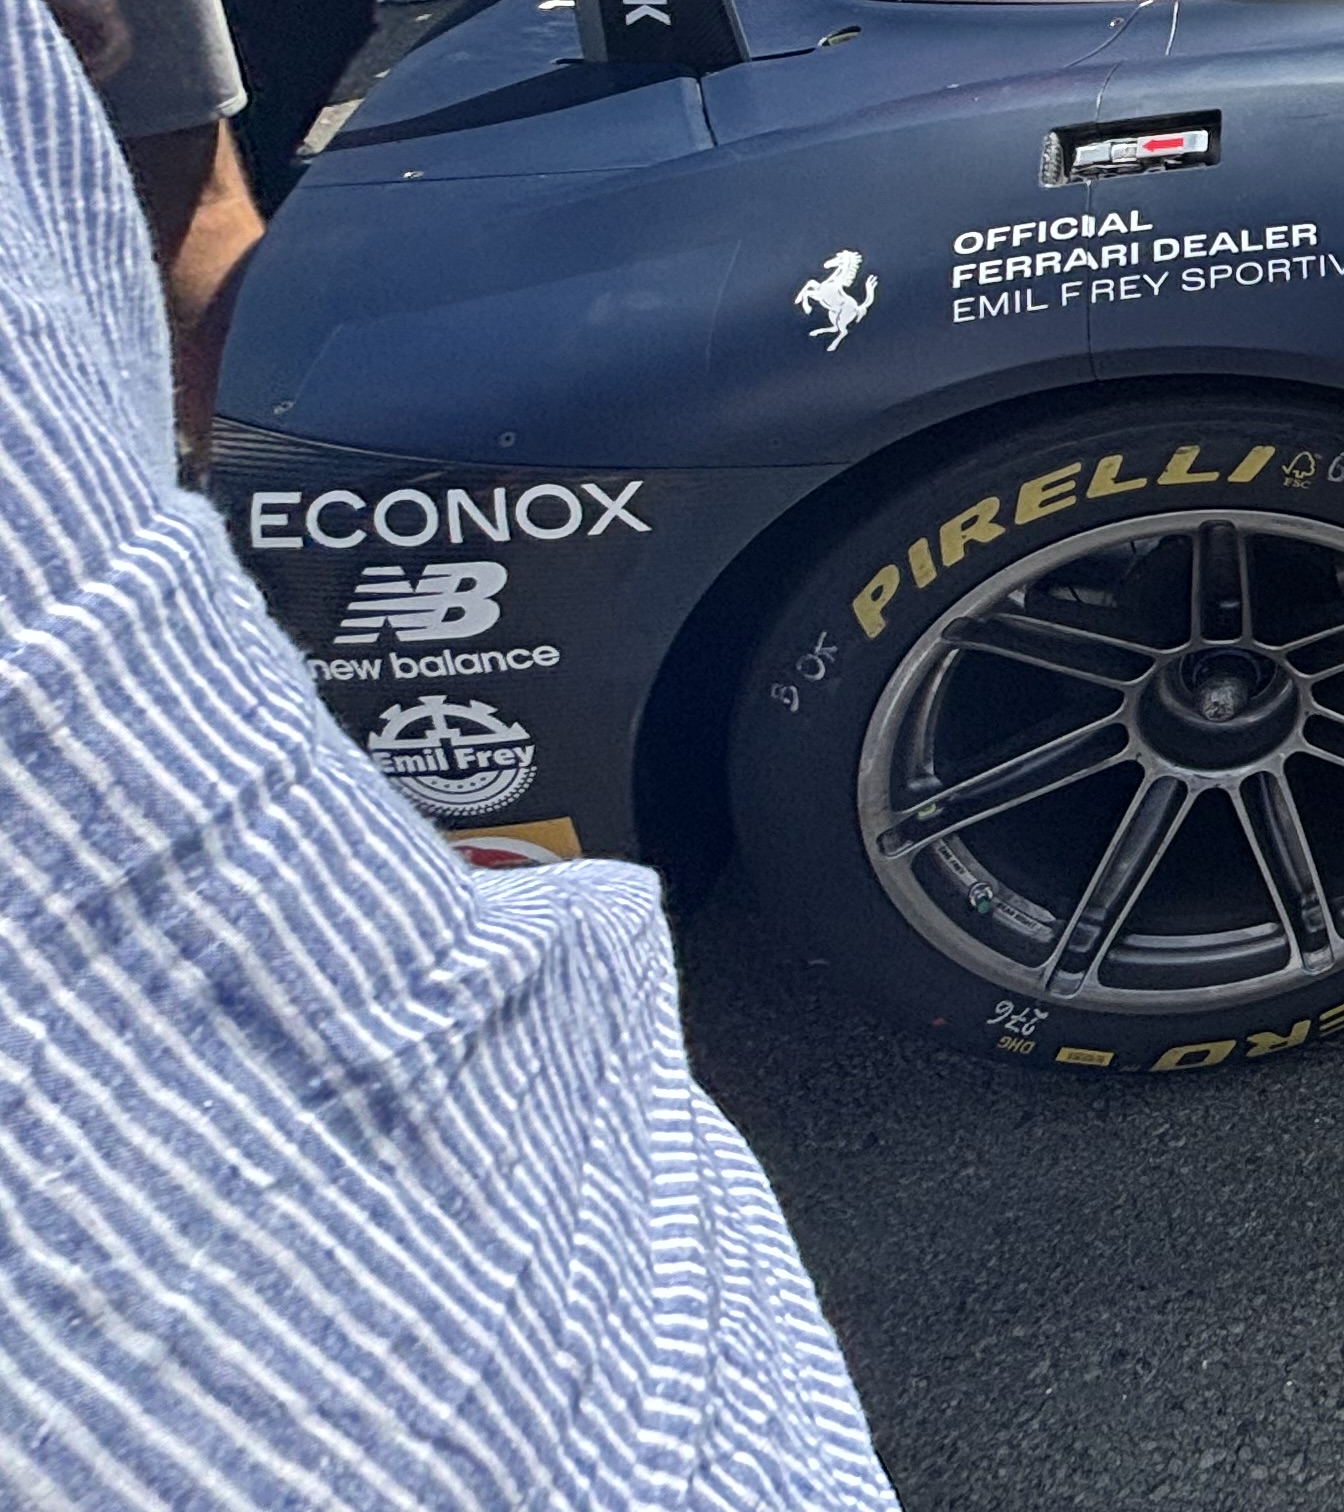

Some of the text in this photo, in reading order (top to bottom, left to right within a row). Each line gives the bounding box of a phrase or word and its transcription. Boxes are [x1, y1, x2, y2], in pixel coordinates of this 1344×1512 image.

[951, 210, 1153, 256] OFFICIAL
[951, 223, 1320, 290] FERRARI DEALER
[953, 287, 1049, 324] EMIL
[1061, 271, 1170, 308] FREY
[250, 480, 652, 549] ECONOX
[851, 445, 1276, 640] PIRELLI
[389, 645, 561, 680] balance
[372, 743, 537, 776] Emil Frey
[986, 999, 1049, 1036] 276
